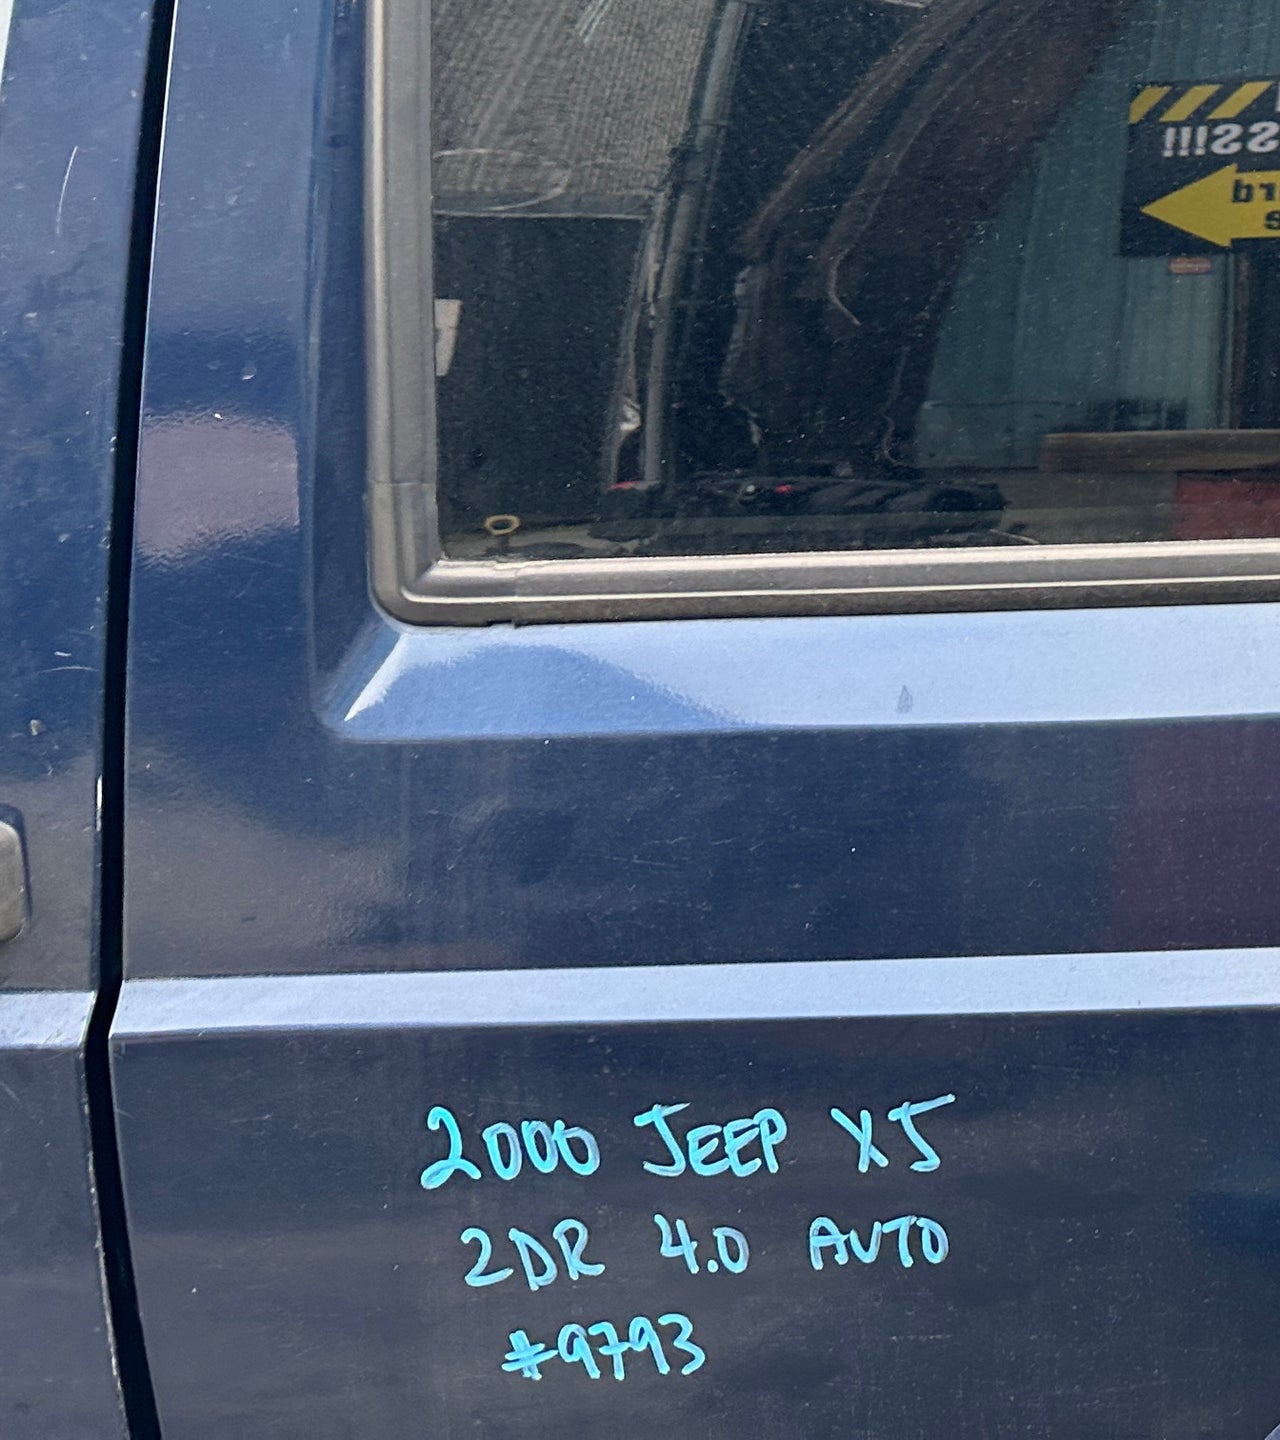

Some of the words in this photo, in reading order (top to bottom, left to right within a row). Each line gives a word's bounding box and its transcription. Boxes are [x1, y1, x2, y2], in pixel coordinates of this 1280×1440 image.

[420, 1106, 601, 1190] 2000
[634, 1102, 788, 1178] JEEP
[460, 1218, 605, 1291] 2DR
[653, 1213, 749, 1274] 4.0
[809, 1215, 950, 1270] AUTO
[501, 1312, 706, 1381] #9793
